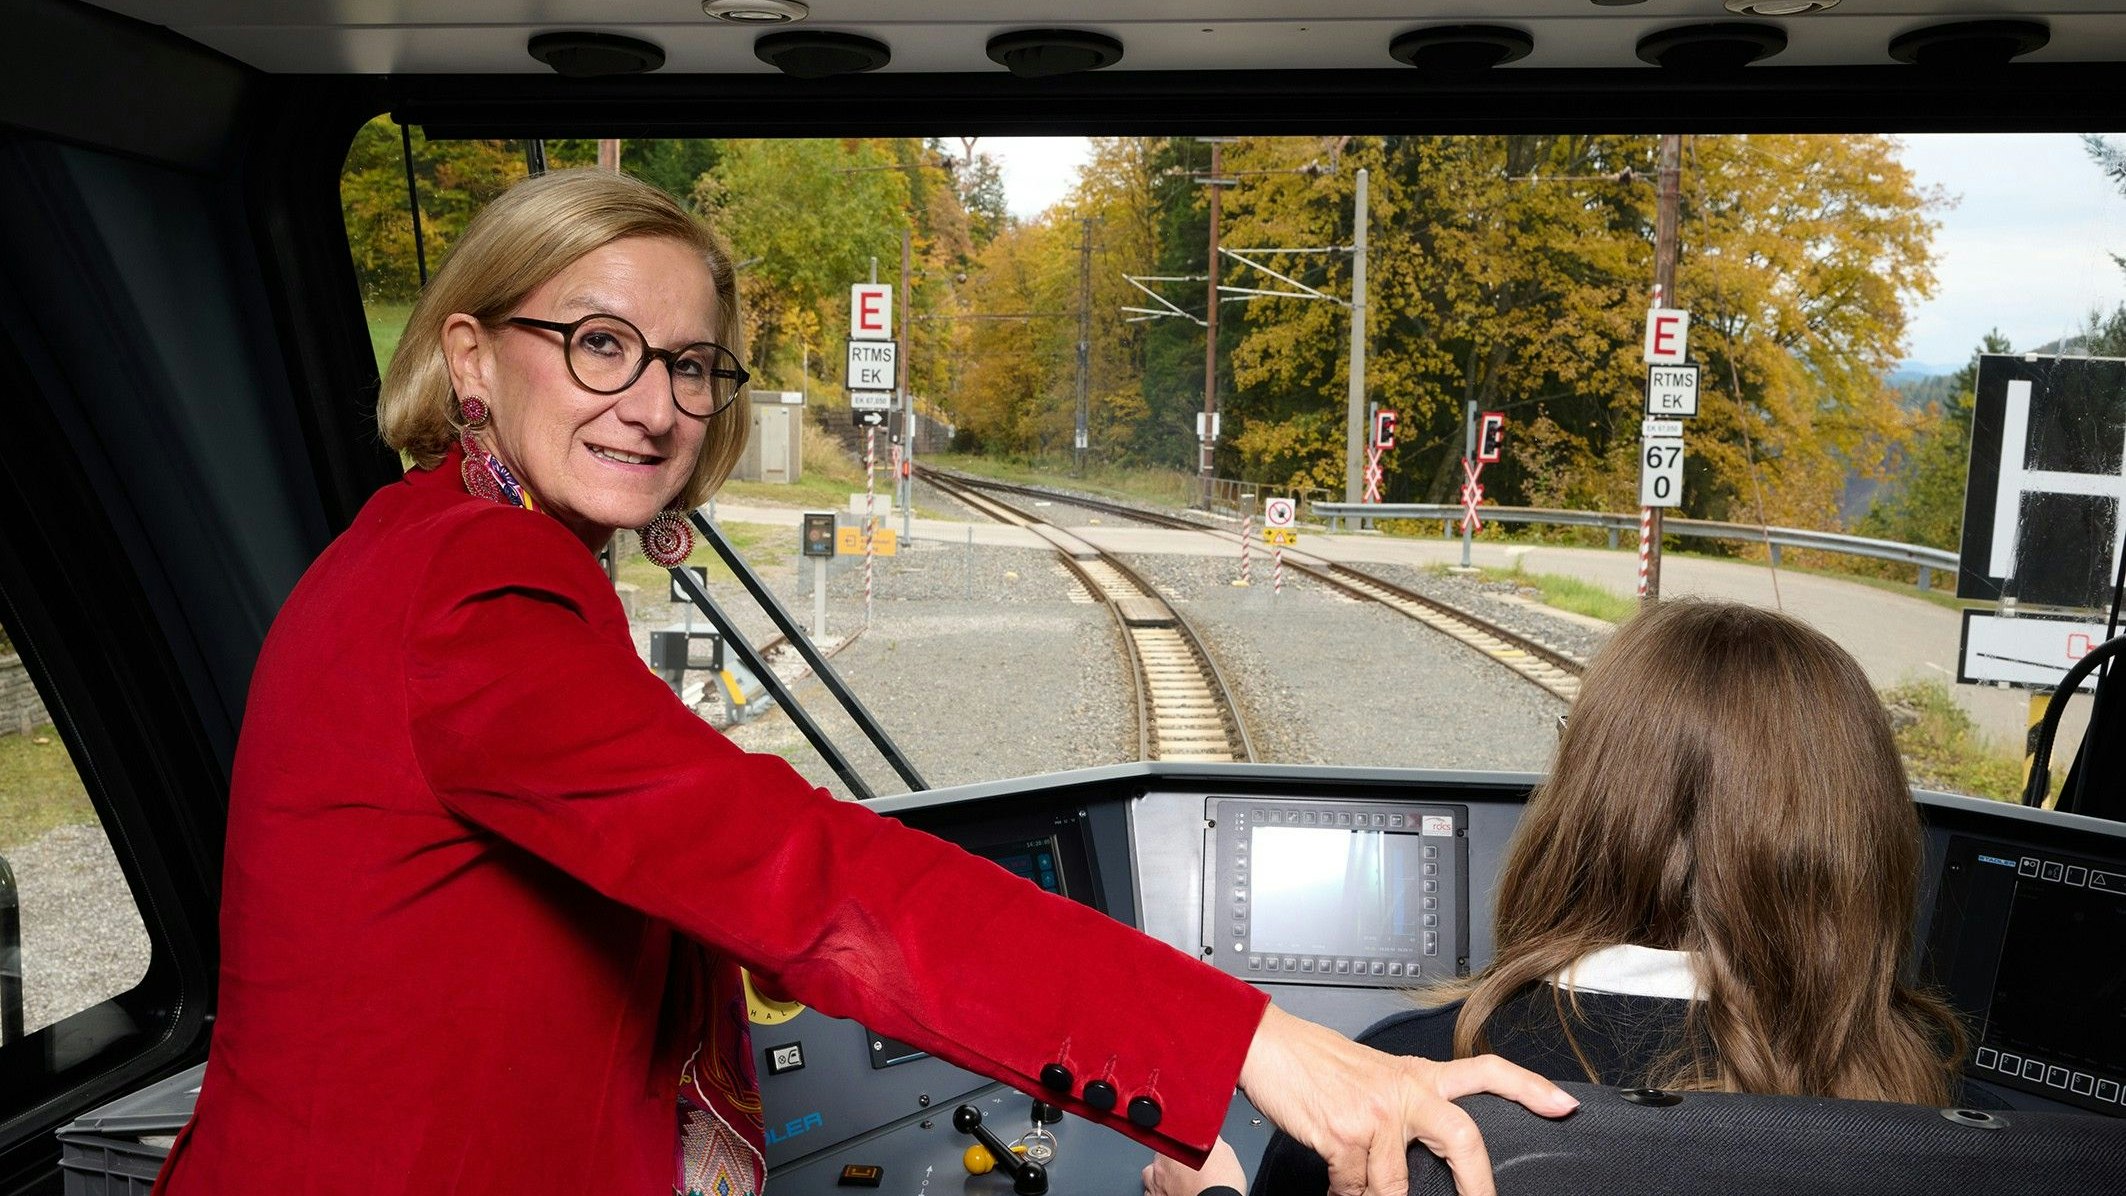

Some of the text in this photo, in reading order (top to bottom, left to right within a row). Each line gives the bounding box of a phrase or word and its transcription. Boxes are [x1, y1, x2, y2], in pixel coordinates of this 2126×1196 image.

[860, 292, 883, 330] E
[1653, 317, 1679, 355] E
[851, 347, 892, 363] RTMS
[861, 368, 882, 384] EK
[1653, 372, 1693, 388] RTMS
[1662, 394, 1683, 409] EK
[1646, 446, 1681, 469] 67
[1654, 476, 1670, 498] 0
[1988, 379, 2126, 587] H
